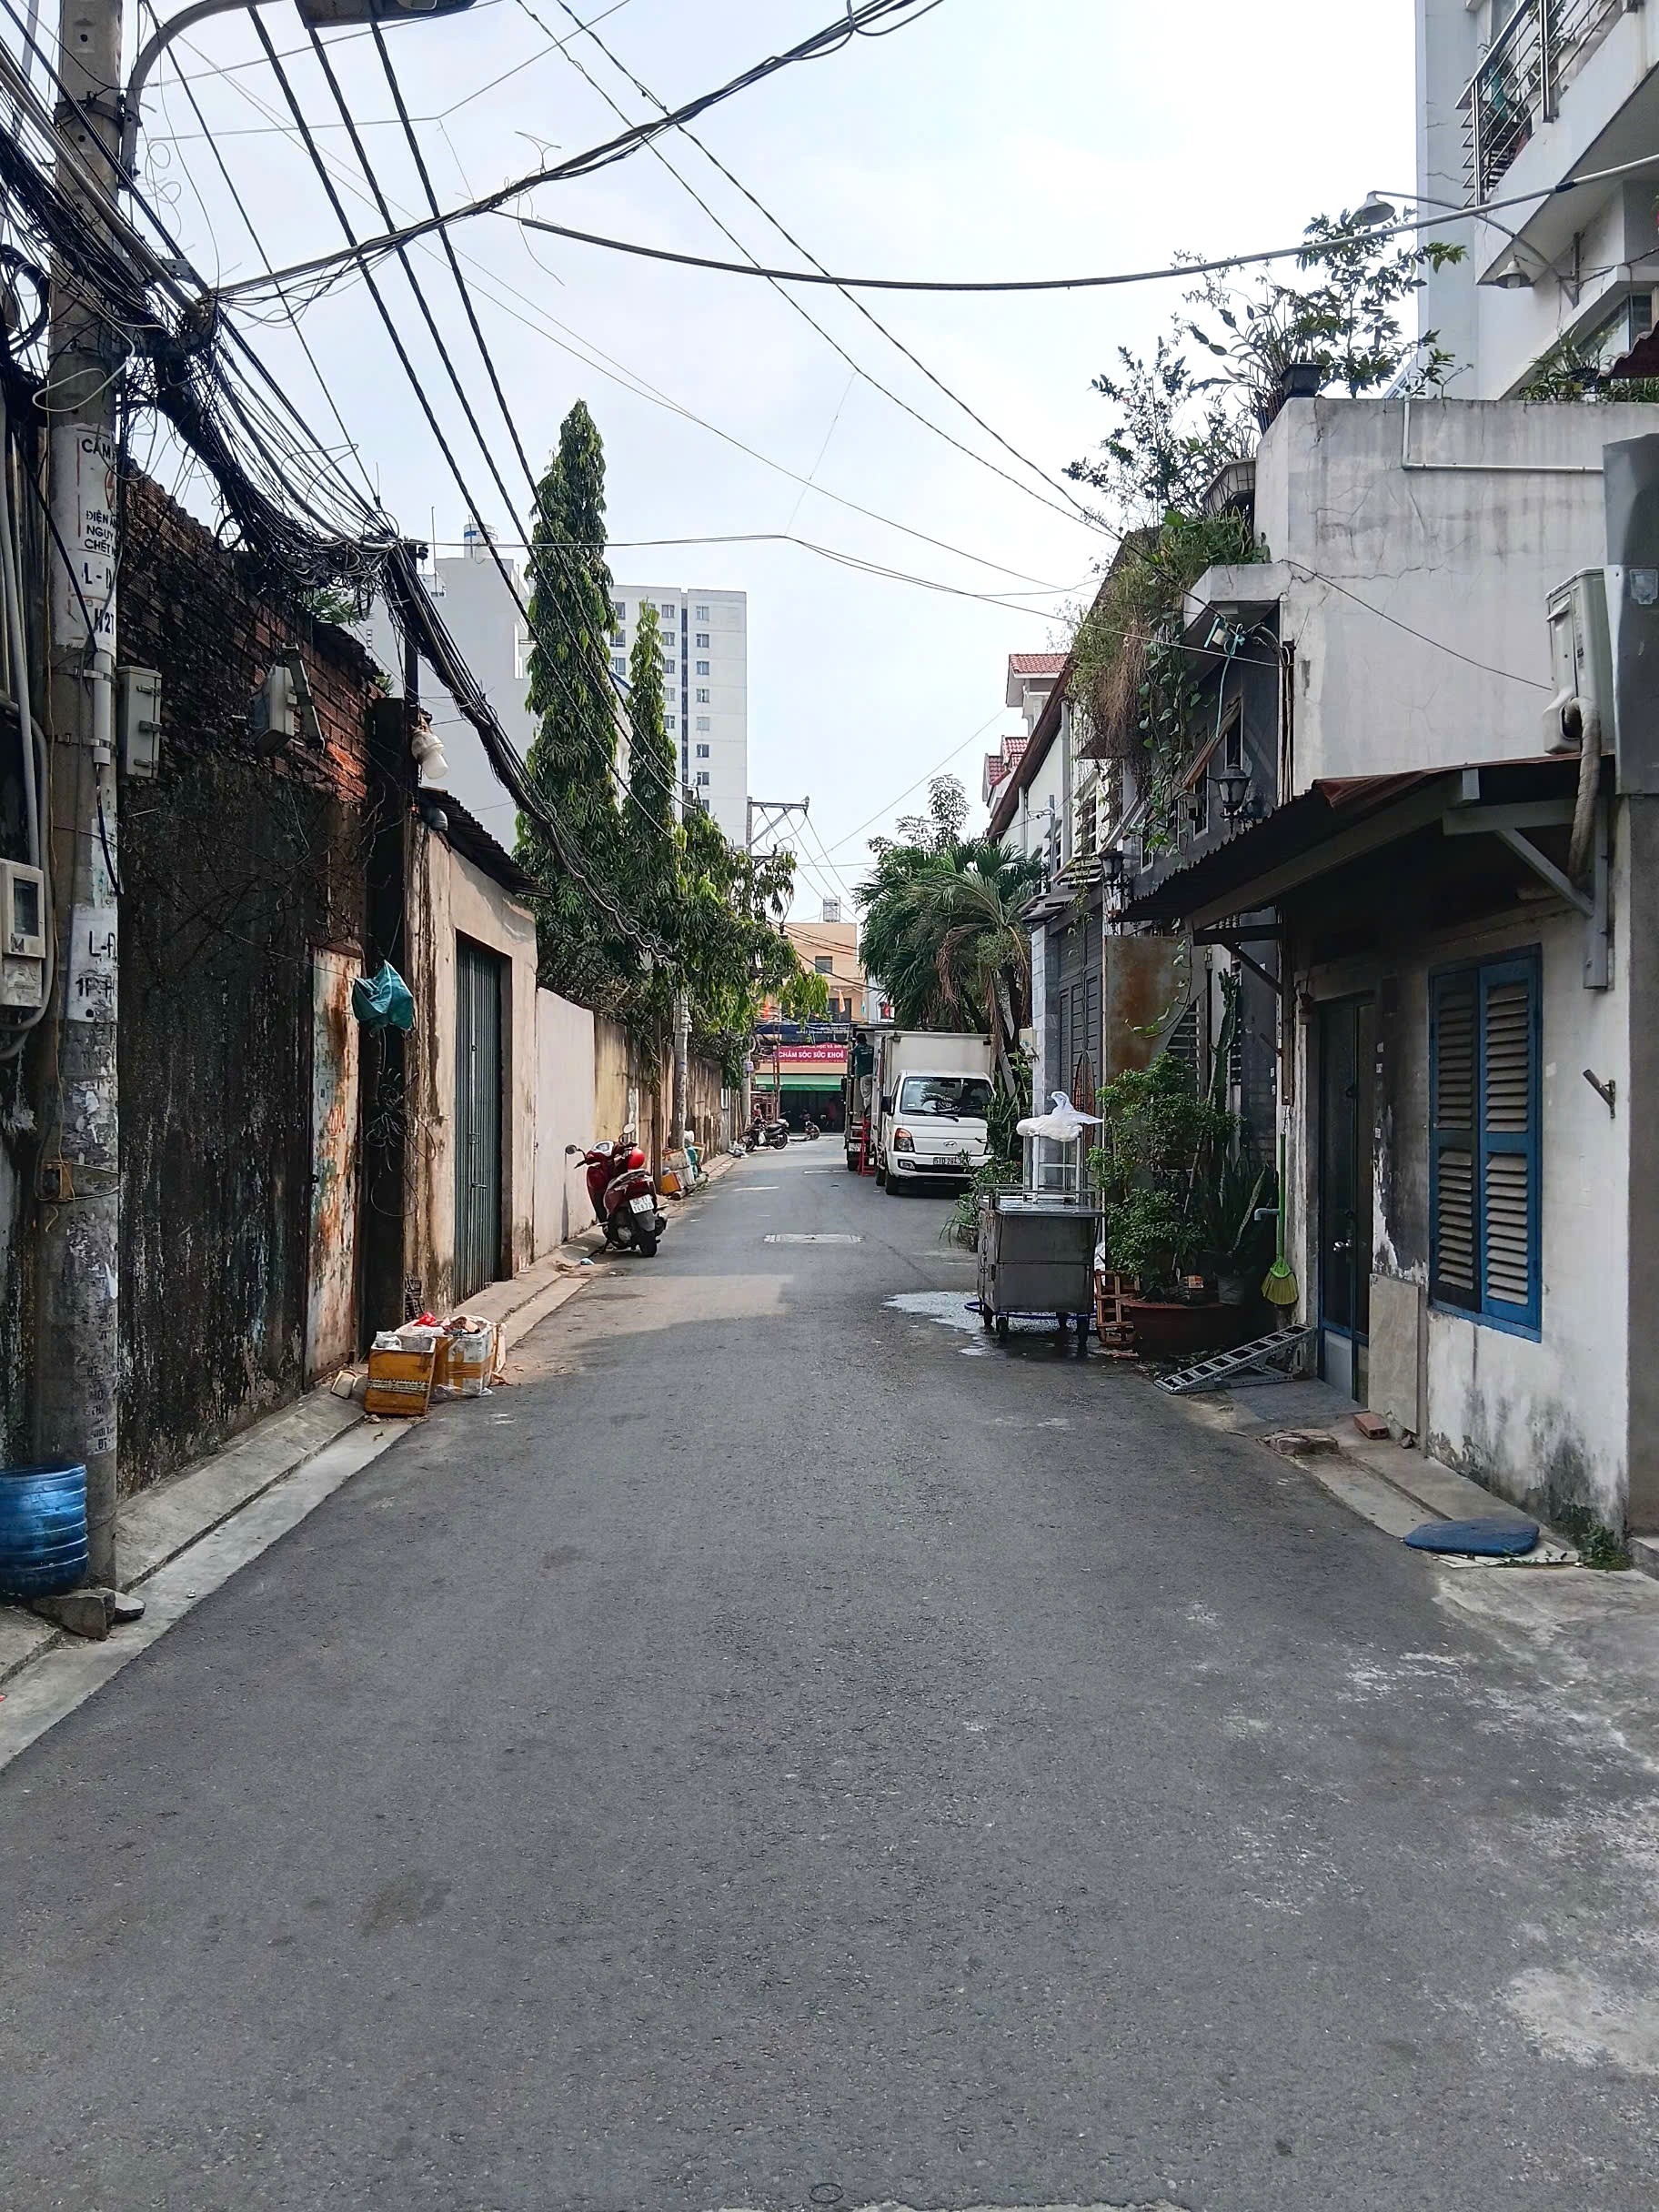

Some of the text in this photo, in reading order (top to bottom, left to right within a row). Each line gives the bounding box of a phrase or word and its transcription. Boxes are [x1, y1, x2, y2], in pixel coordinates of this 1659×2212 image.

[85, 509, 108, 525] ĐIỆN
[86, 525, 113, 541] NGUY
[85, 538, 110, 554] CHẾT
[799, 1050, 812, 1059] SÓC
